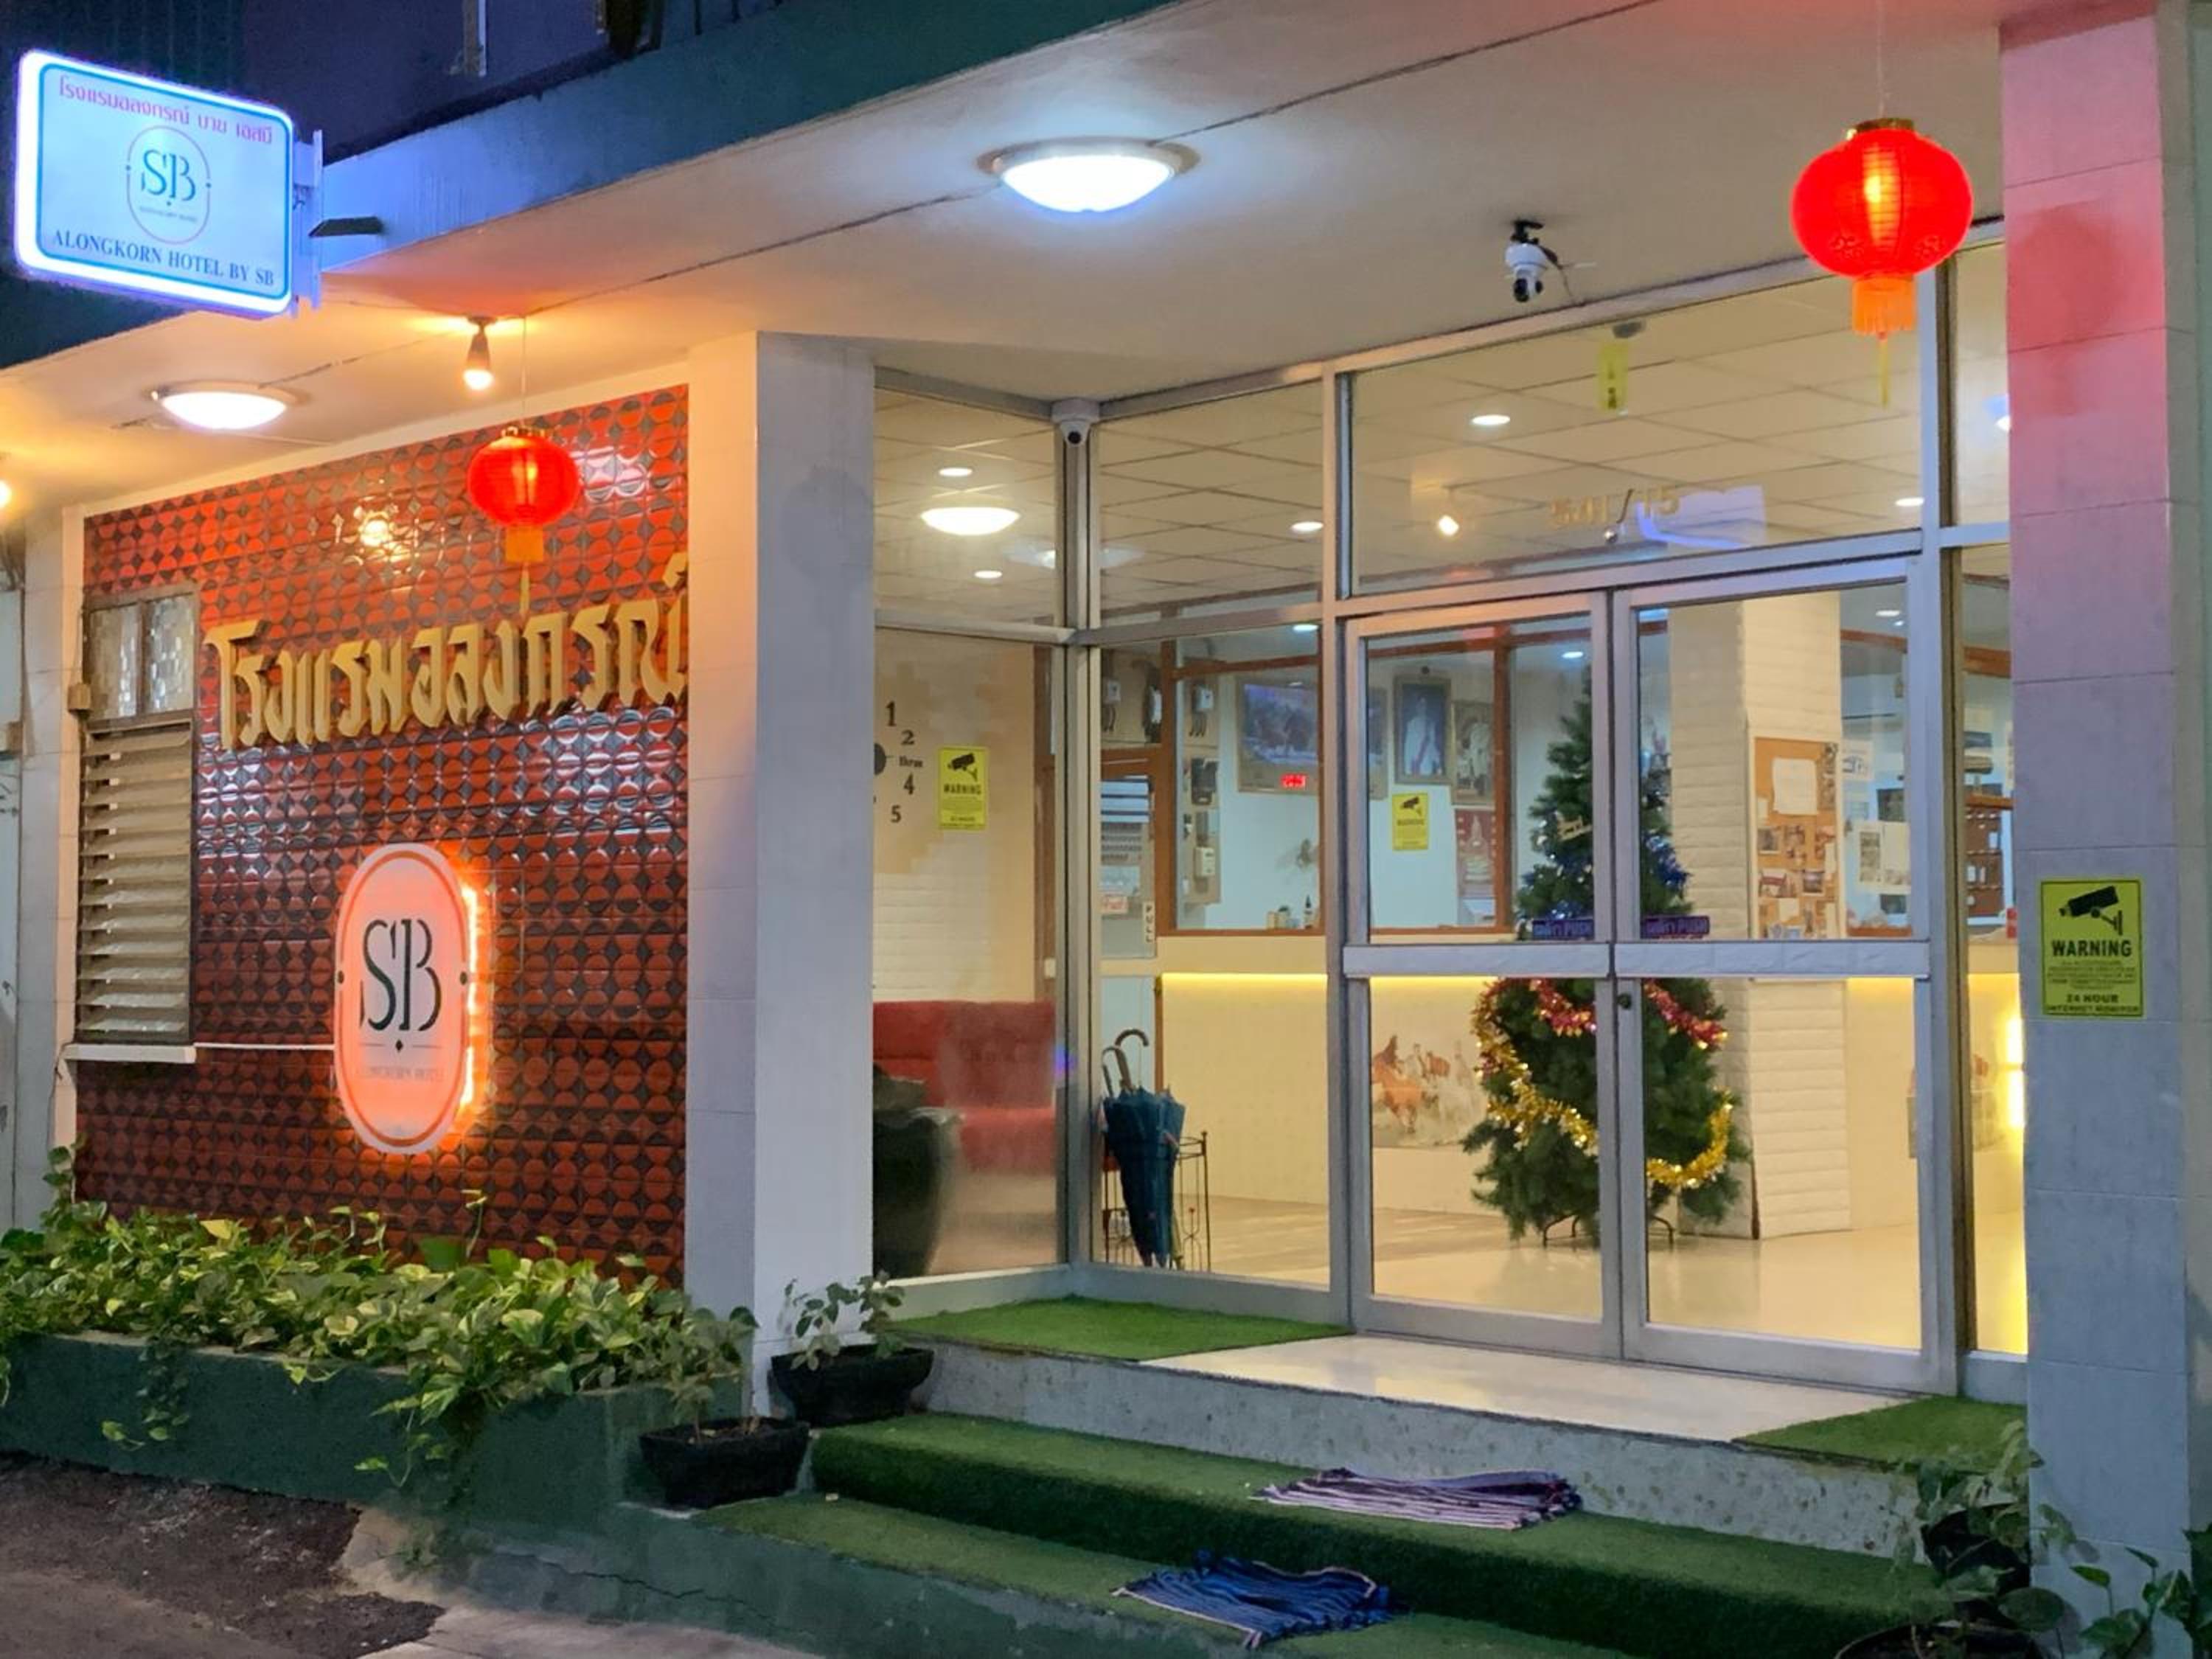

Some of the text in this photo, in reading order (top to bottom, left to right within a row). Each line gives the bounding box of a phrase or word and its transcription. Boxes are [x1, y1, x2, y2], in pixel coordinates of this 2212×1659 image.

[53, 229, 274, 286] ALONGKORN HOTEL BY SB
[886, 700, 897, 727] 1
[900, 728, 916, 746] 2
[902, 772, 915, 796] 4
[943, 783, 982, 796] WARNING
[890, 804, 902, 824] 5
[1145, 904, 1155, 943] PULL
[2052, 939, 2132, 957] WARNING
[360, 918, 442, 1032] SB
[2083, 994, 2119, 1004] HOUR
